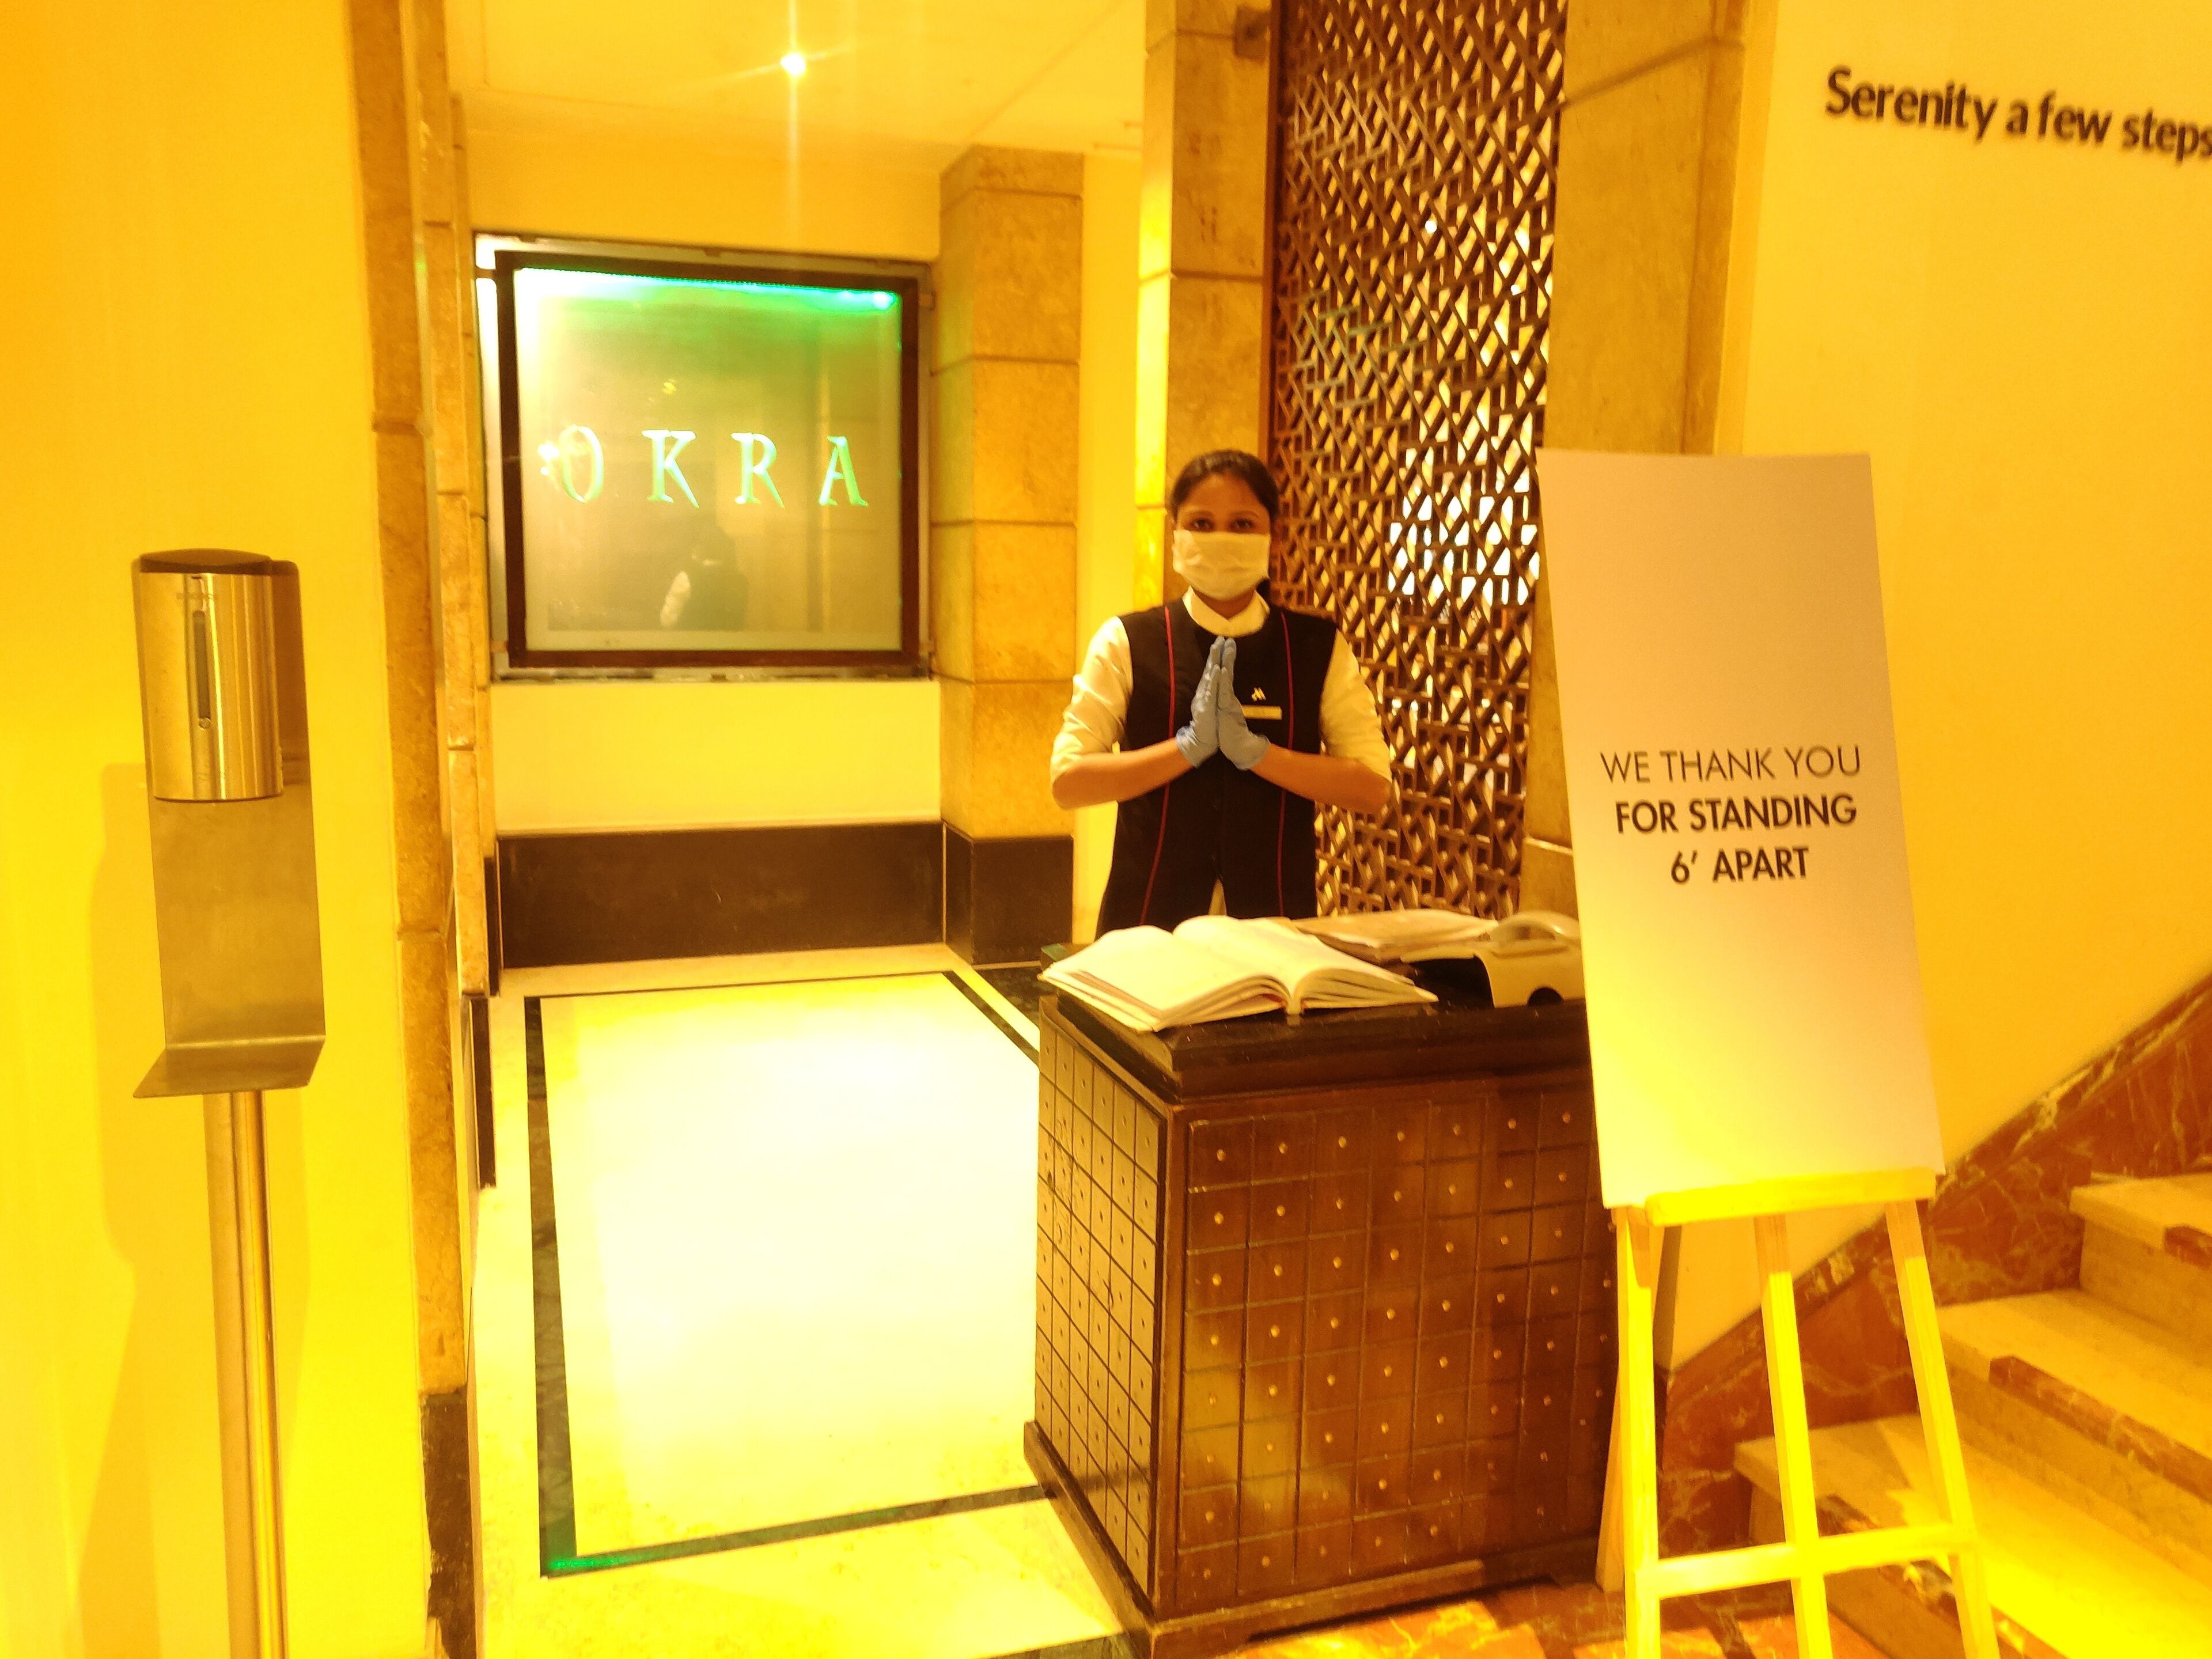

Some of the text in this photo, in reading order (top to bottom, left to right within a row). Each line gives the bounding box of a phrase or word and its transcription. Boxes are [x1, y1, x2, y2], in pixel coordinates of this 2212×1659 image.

[1825, 64, 2212, 165] Serenity a few steps
[559, 425, 869, 509] OKRA
[1600, 744, 1861, 784] WE THANK YOU
[1615, 793, 1858, 834] FOR STANDING
[1712, 846, 1809, 882] APART
